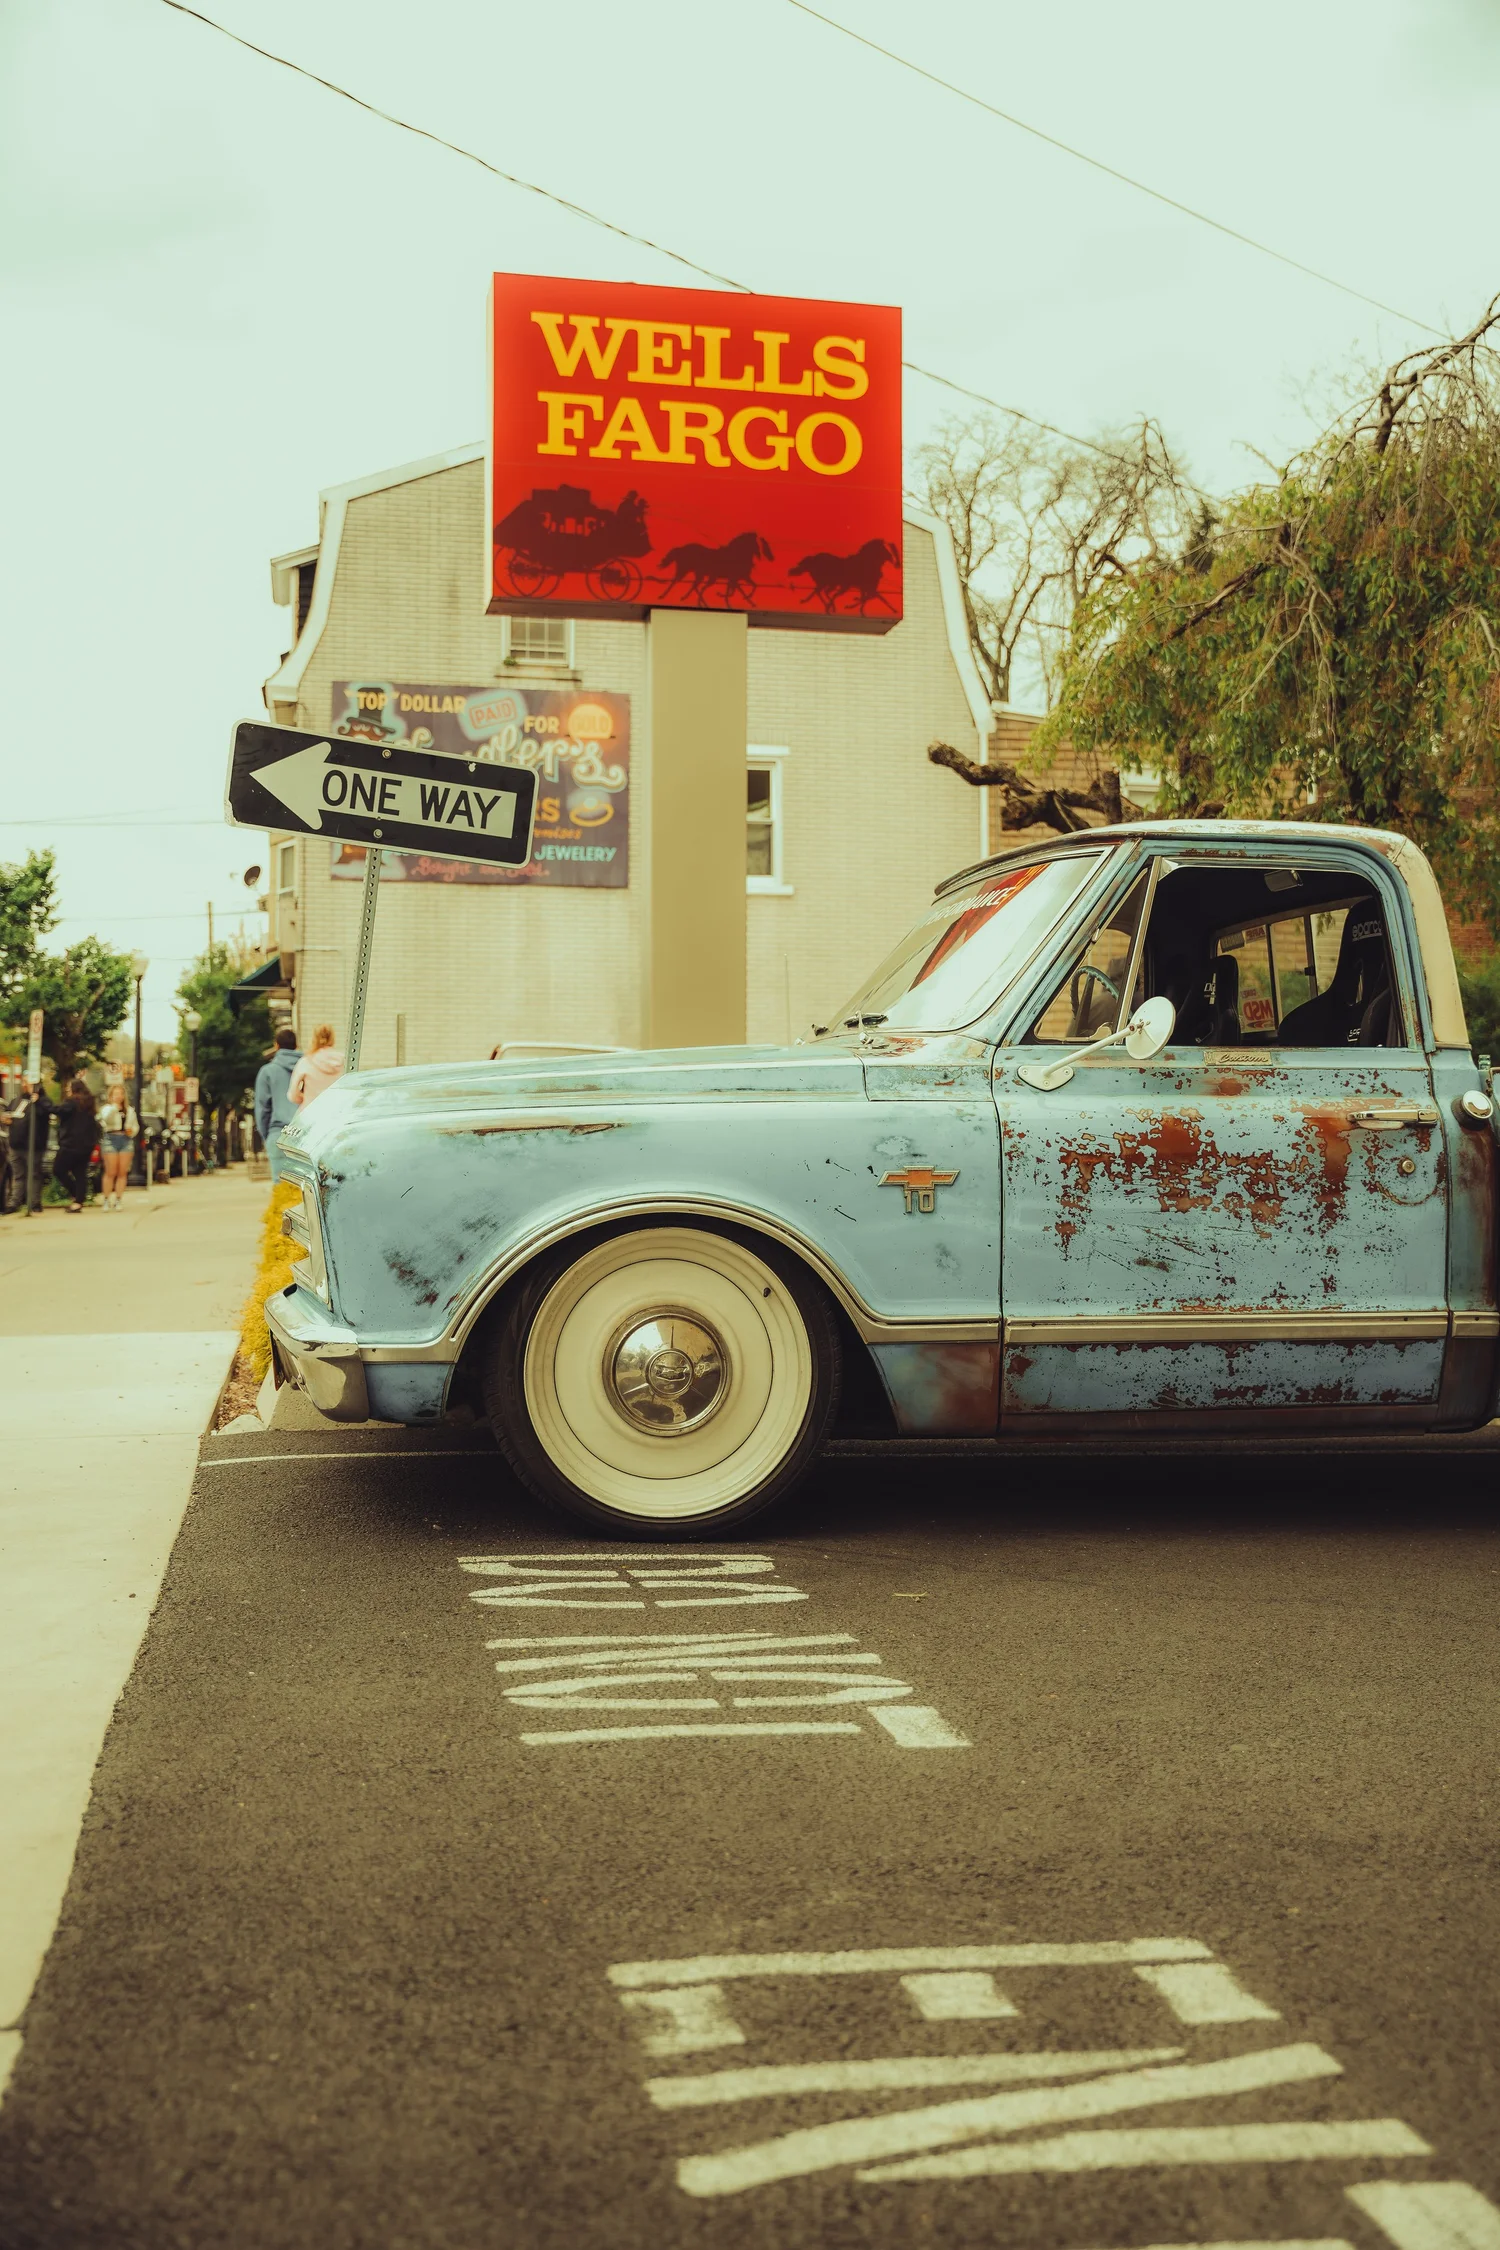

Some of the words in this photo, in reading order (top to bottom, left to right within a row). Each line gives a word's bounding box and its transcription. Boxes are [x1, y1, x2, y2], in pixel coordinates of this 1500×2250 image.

[531, 311, 869, 400] WELLS
[537, 391, 862, 475] FARGO
[401, 693, 466, 714] DOLLAR
[474, 703, 512, 723] PAID
[524, 715, 560, 734] FOR
[322, 770, 402, 816] ONE
[420, 784, 501, 830] WAY
[534, 844, 617, 862] JEWELERY
[1219, 1053, 1269, 1063] Custom
[904, 1189, 935, 1213] 10
[457, 1554, 810, 1608] DO
[485, 1630, 973, 1748] NOT
